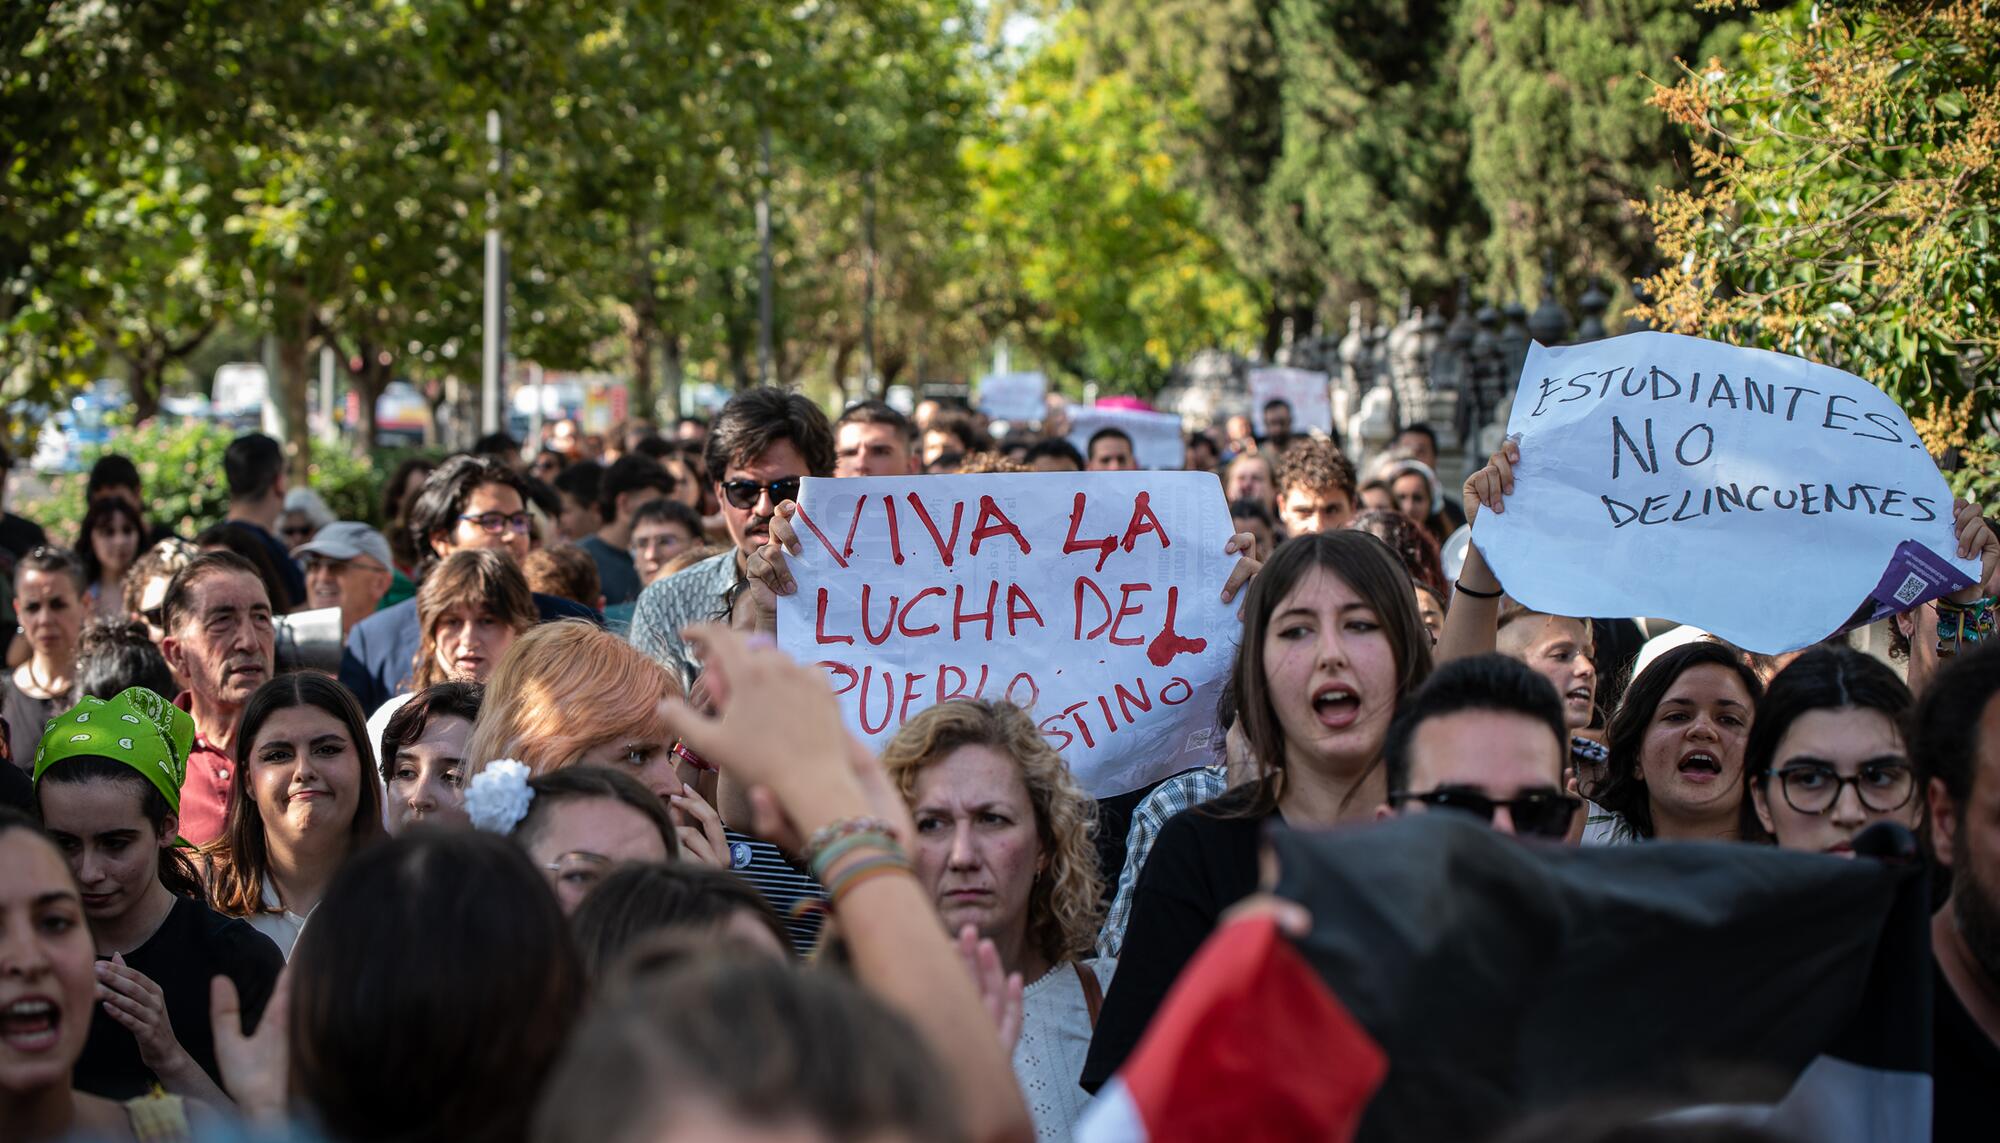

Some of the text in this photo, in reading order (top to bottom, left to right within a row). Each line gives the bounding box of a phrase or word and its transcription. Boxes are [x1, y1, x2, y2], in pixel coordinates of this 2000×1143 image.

[1612, 415, 1715, 480] NO
[796, 491, 1032, 568] VIVA
[1063, 491, 1171, 572] LA
[1600, 483, 1937, 529] DELINCUENTES
[815, 580, 1044, 647] LUCHA
[1074, 575, 1207, 668] DEL
[1038, 676, 1194, 752] STINO
